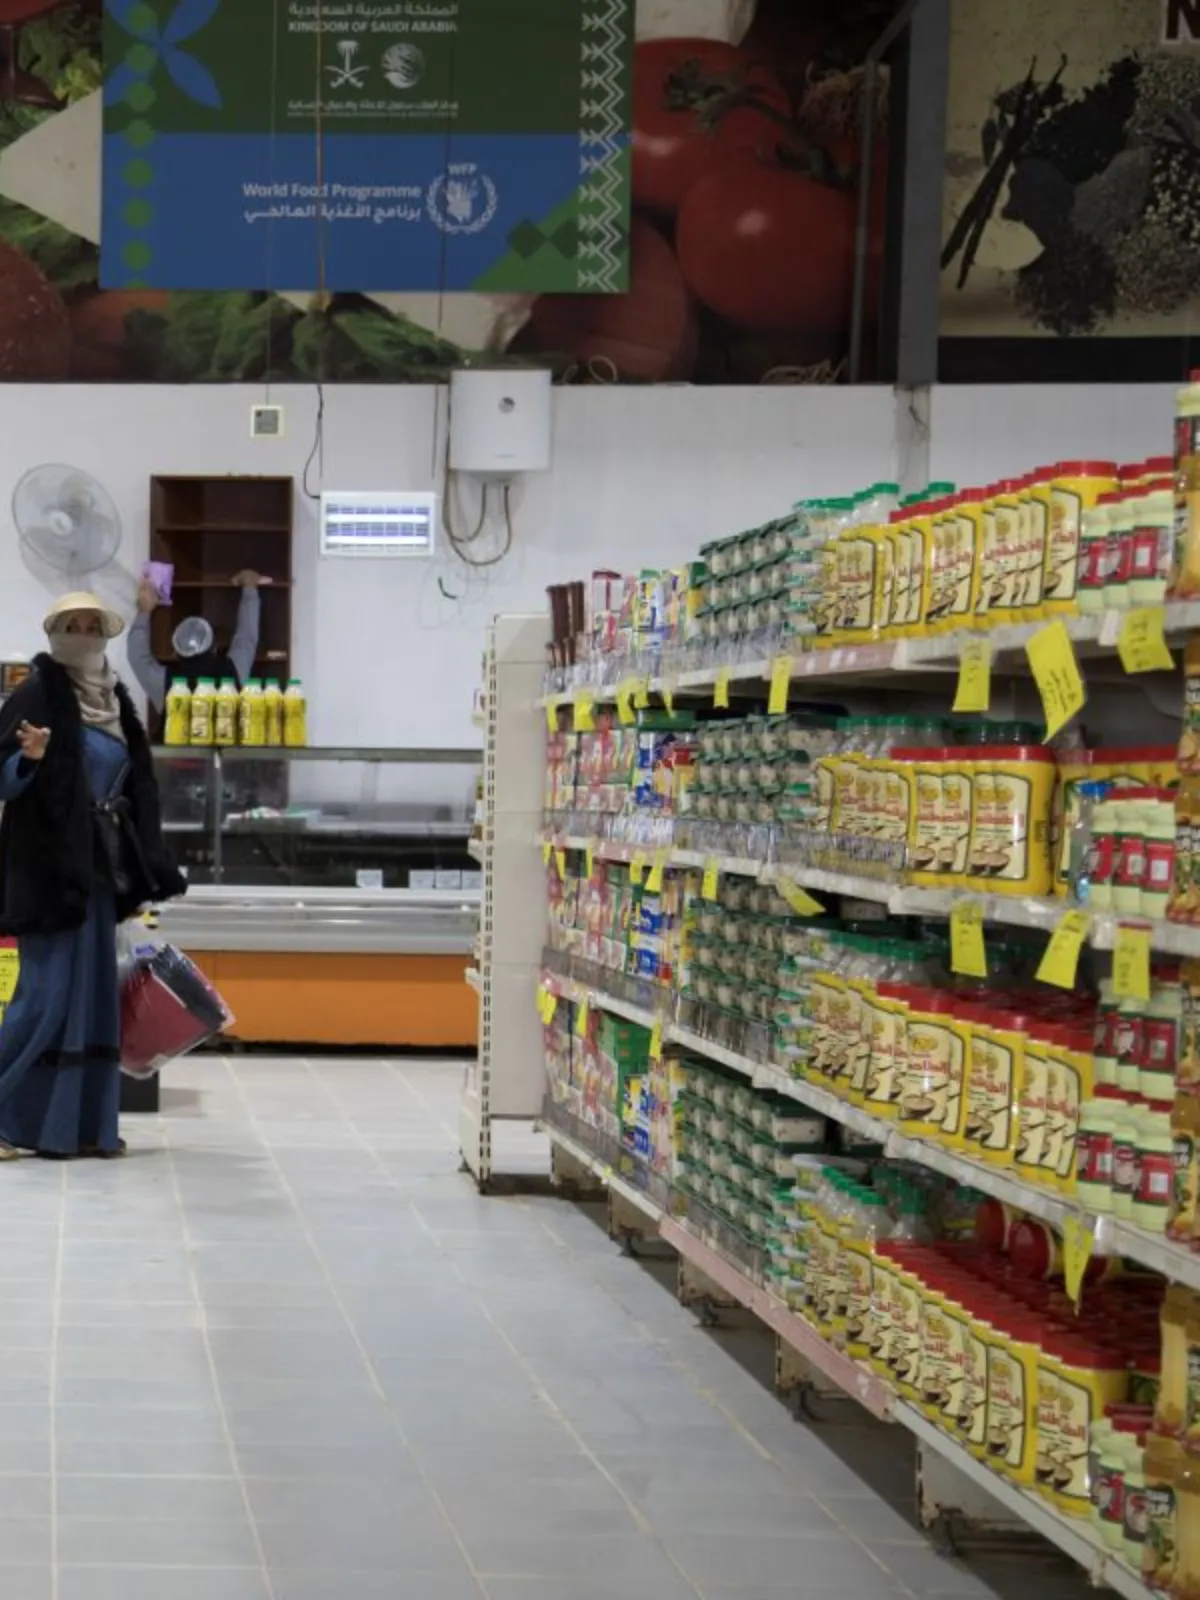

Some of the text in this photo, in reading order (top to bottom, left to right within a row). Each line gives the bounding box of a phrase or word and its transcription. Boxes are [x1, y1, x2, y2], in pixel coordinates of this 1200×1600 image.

[356, 3, 401, 18] العربية
[404, 2, 458, 16] المملكة
[288, 21, 458, 32] KINGDOM OF SAUDI ARABIA
[448, 163, 476, 175] WFP
[243, 183, 421, 202] World Food Programme
[373, 205, 421, 224] برنامج
